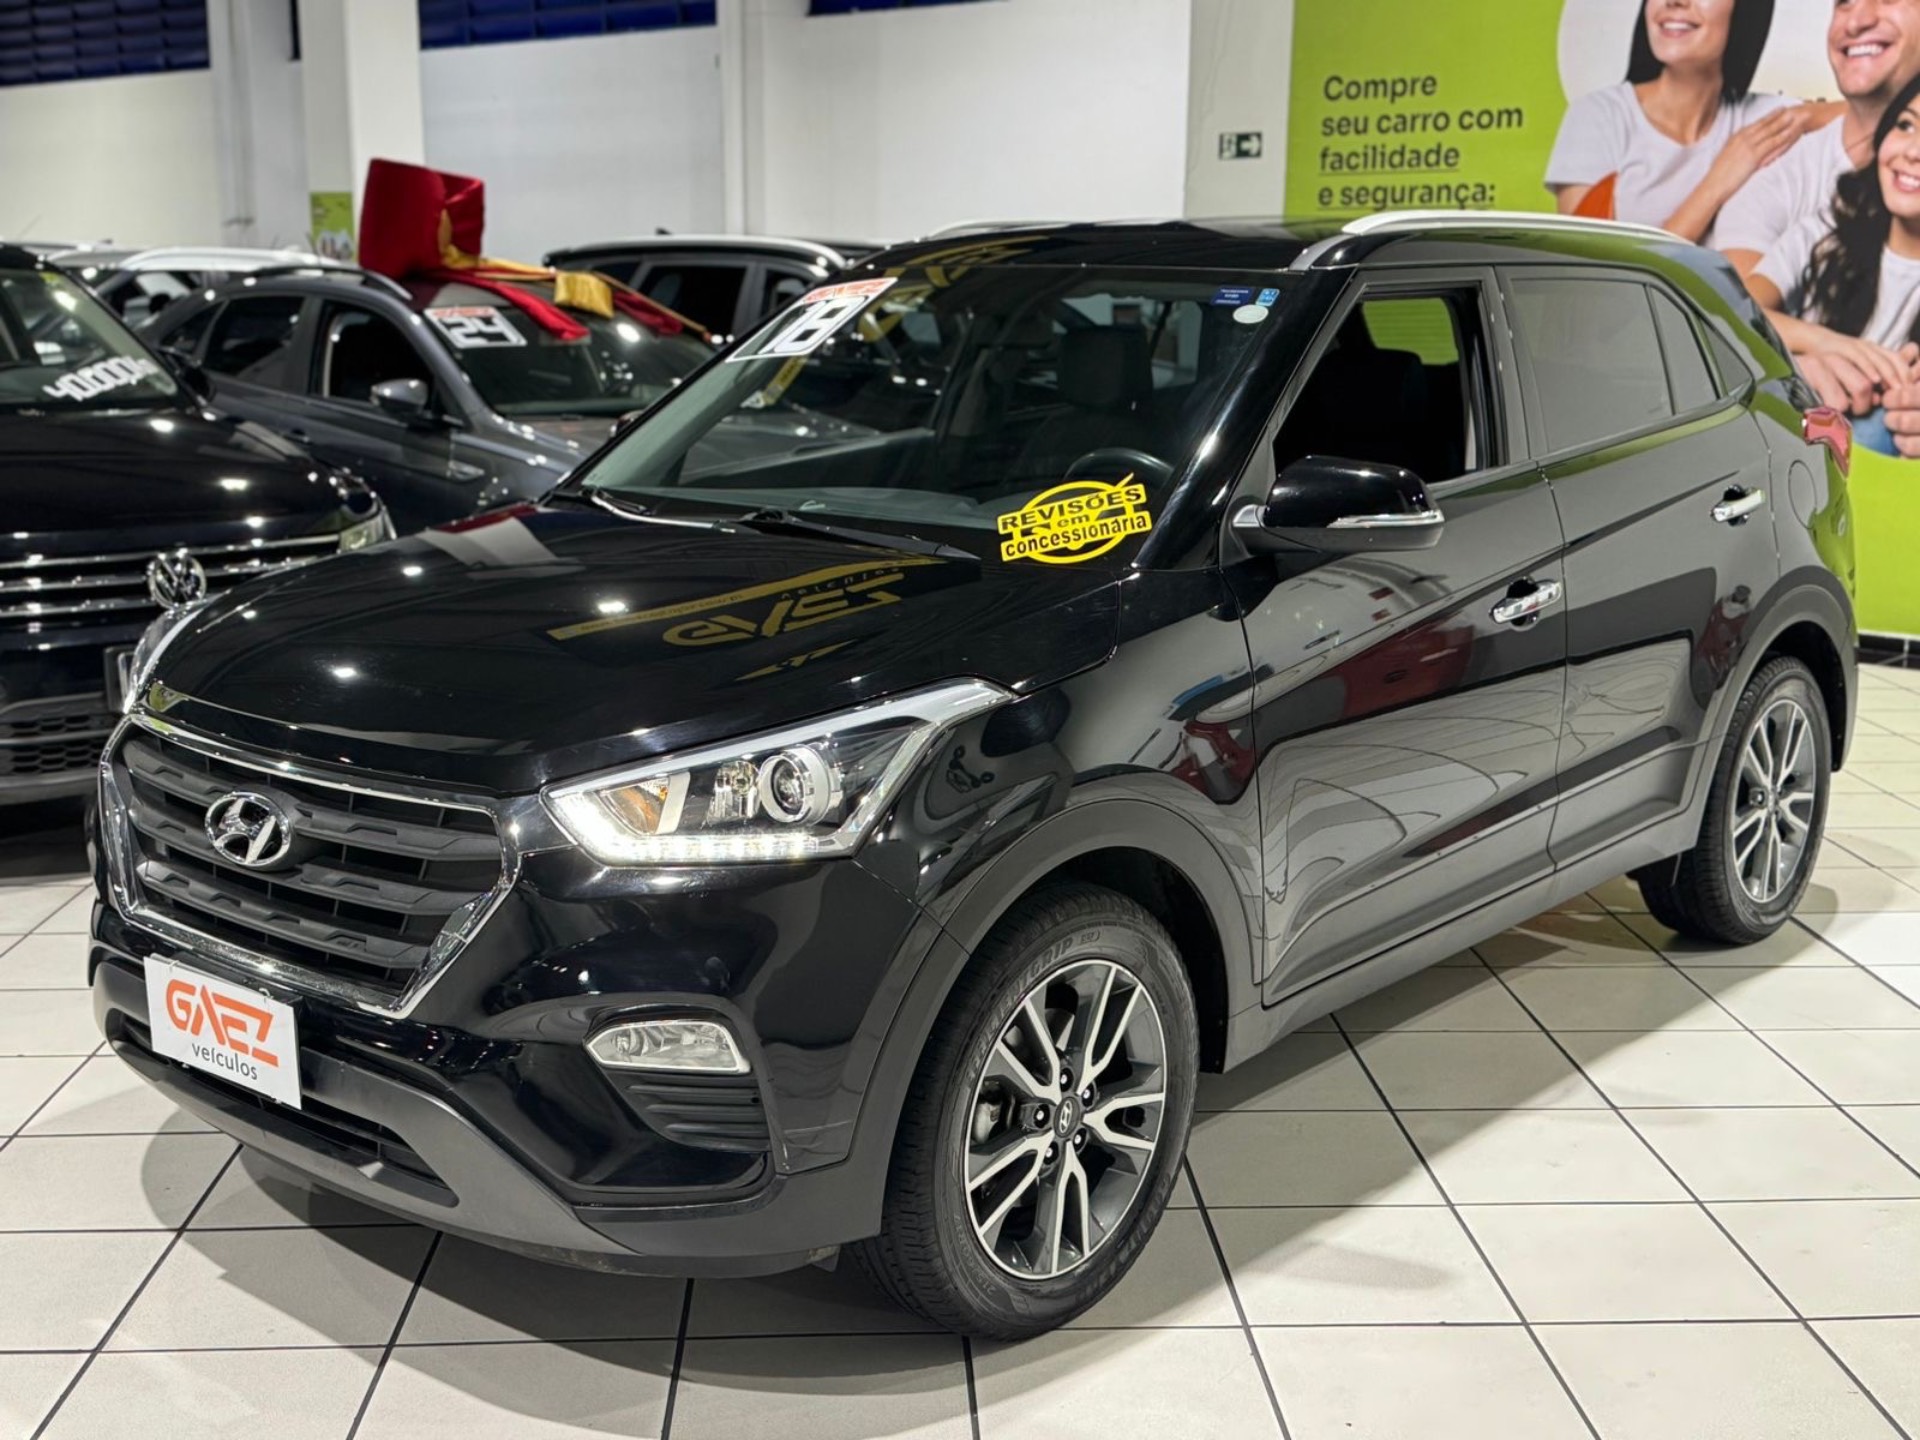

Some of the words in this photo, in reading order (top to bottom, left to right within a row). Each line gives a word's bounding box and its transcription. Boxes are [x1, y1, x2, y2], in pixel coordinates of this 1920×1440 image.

[1323, 74, 1437, 104] Compre
[1321, 114, 1368, 137] seu
[1376, 109, 1450, 134] carro
[1457, 106, 1523, 131] com
[1319, 142, 1460, 172] facilidade
[1318, 186, 1334, 207] e
[1341, 182, 1495, 212] segurança:
[441, 315, 518, 347] 24
[757, 294, 868, 355] 18
[1001, 487, 1142, 531] REVISÕES
[1057, 513, 1091, 527] em
[165, 978, 280, 1068] GAEZ
[191, 1042, 259, 1081] veículos
